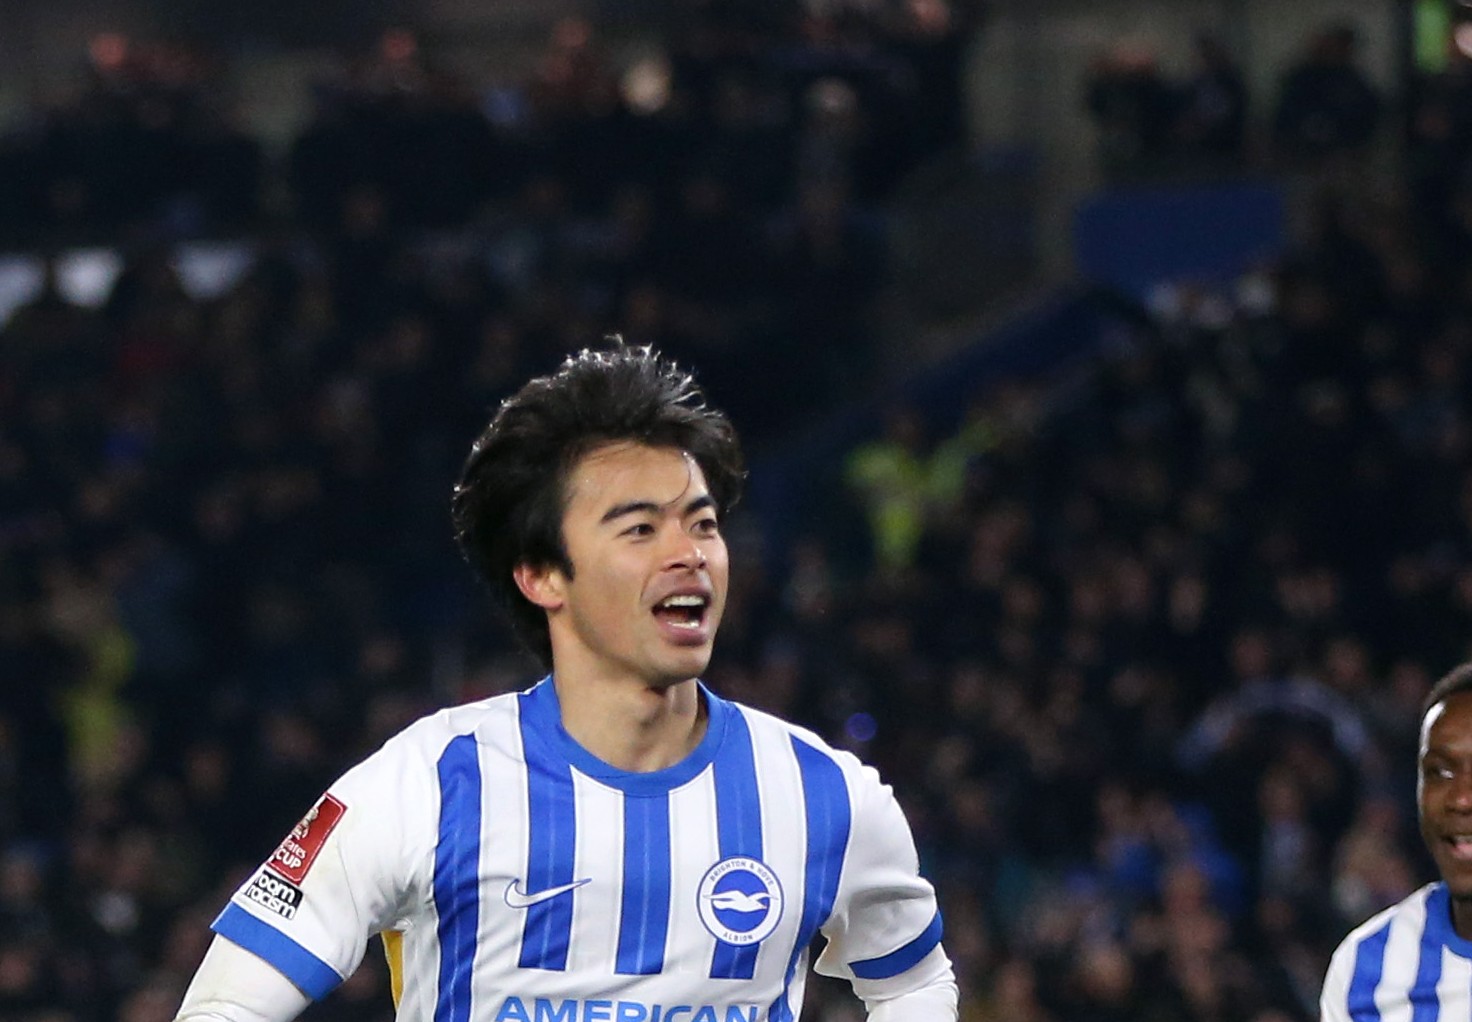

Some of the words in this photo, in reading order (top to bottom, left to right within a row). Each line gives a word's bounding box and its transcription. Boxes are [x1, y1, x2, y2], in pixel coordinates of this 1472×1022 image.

[276, 848, 302, 868] CUP
[709, 860, 747, 882] BRIGHTON
[757, 866, 775, 886] HOVE
[722, 932, 754, 942] ALBION
